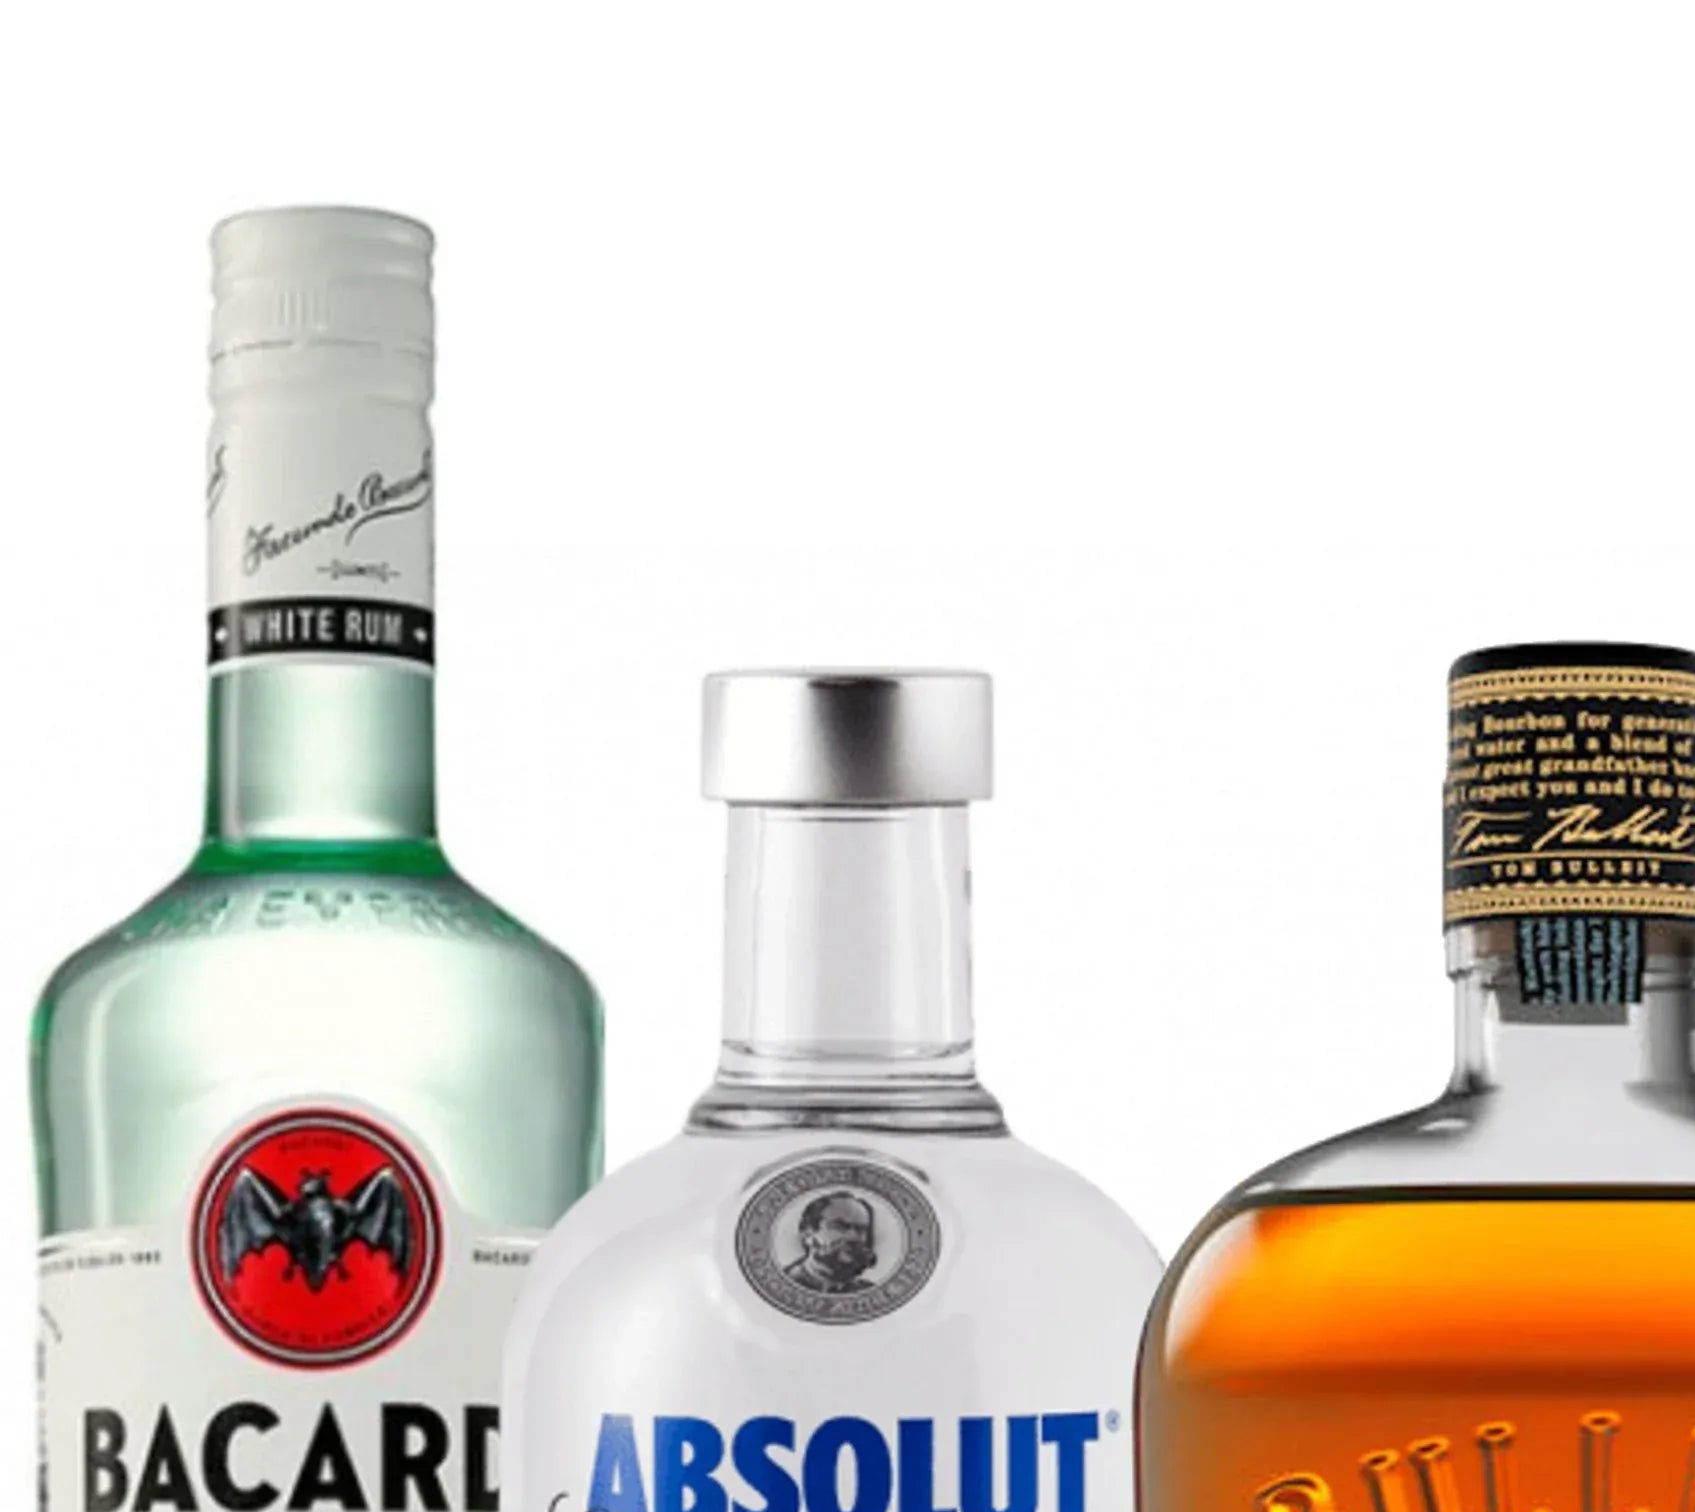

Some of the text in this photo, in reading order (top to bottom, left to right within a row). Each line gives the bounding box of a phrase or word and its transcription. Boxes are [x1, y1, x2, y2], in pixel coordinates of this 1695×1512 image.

[243, 606, 404, 645] WHITE RUM
[1539, 756, 1669, 778] grandfather
[1490, 859, 1662, 878] TOM BULLEIT
